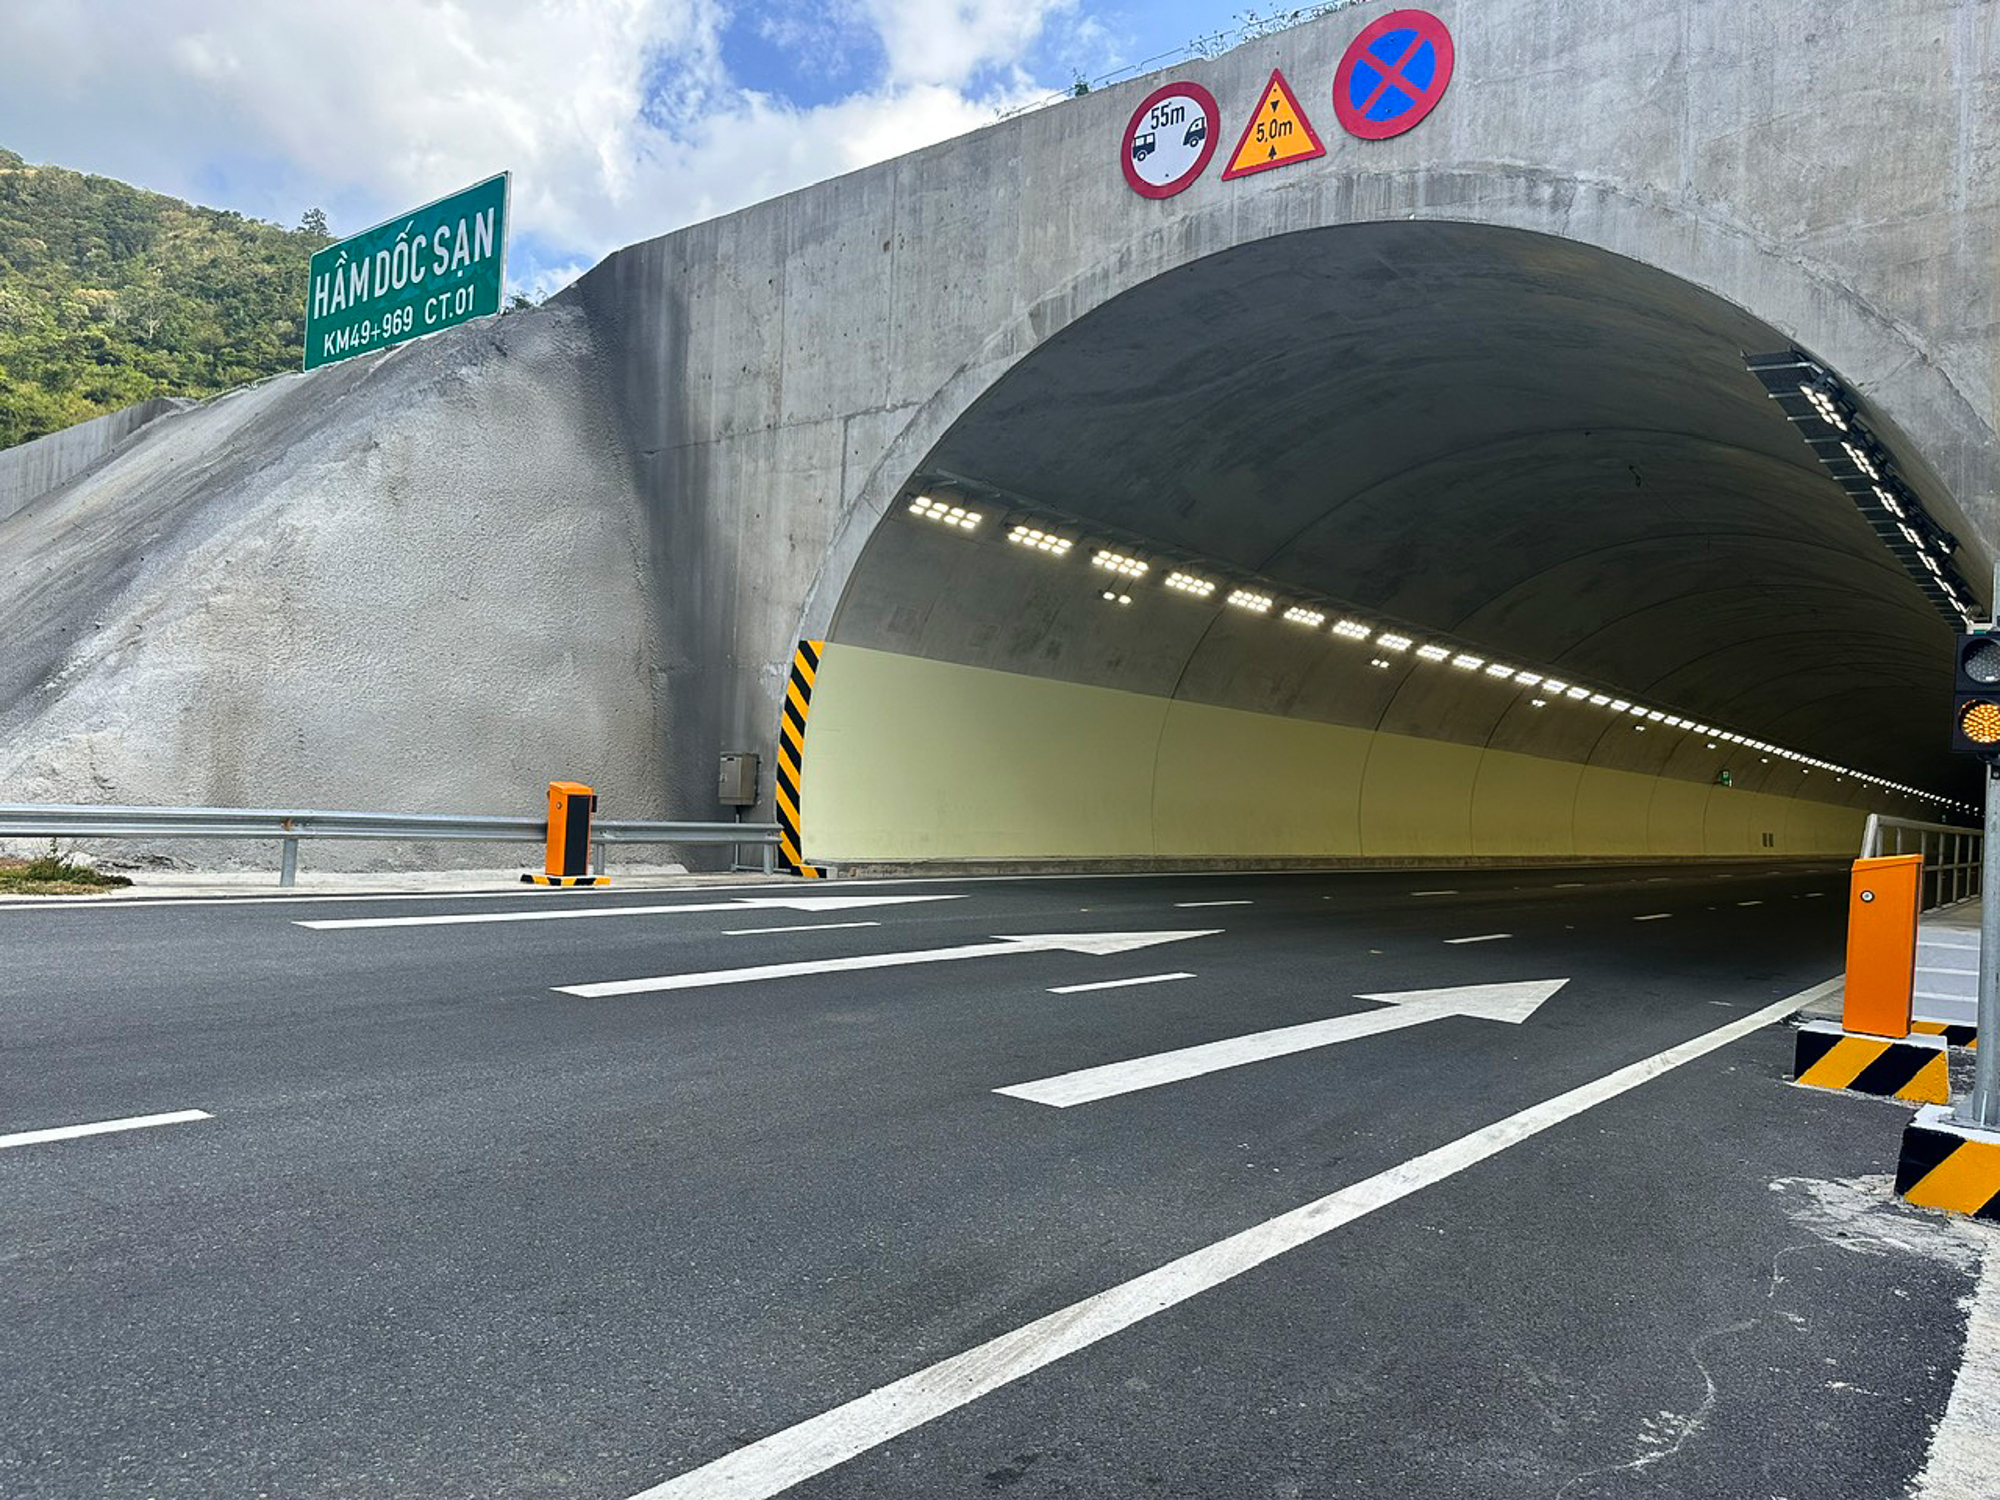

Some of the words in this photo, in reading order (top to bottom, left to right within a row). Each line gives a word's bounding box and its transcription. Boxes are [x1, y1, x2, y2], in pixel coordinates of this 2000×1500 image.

[1150, 103, 1185, 130] 55m
[313, 250, 371, 319] HẦM
[374, 220, 427, 298] DỐC
[433, 207, 495, 277] SẠN
[323, 305, 414, 357] KM49+969
[424, 284, 475, 324] CT.01
